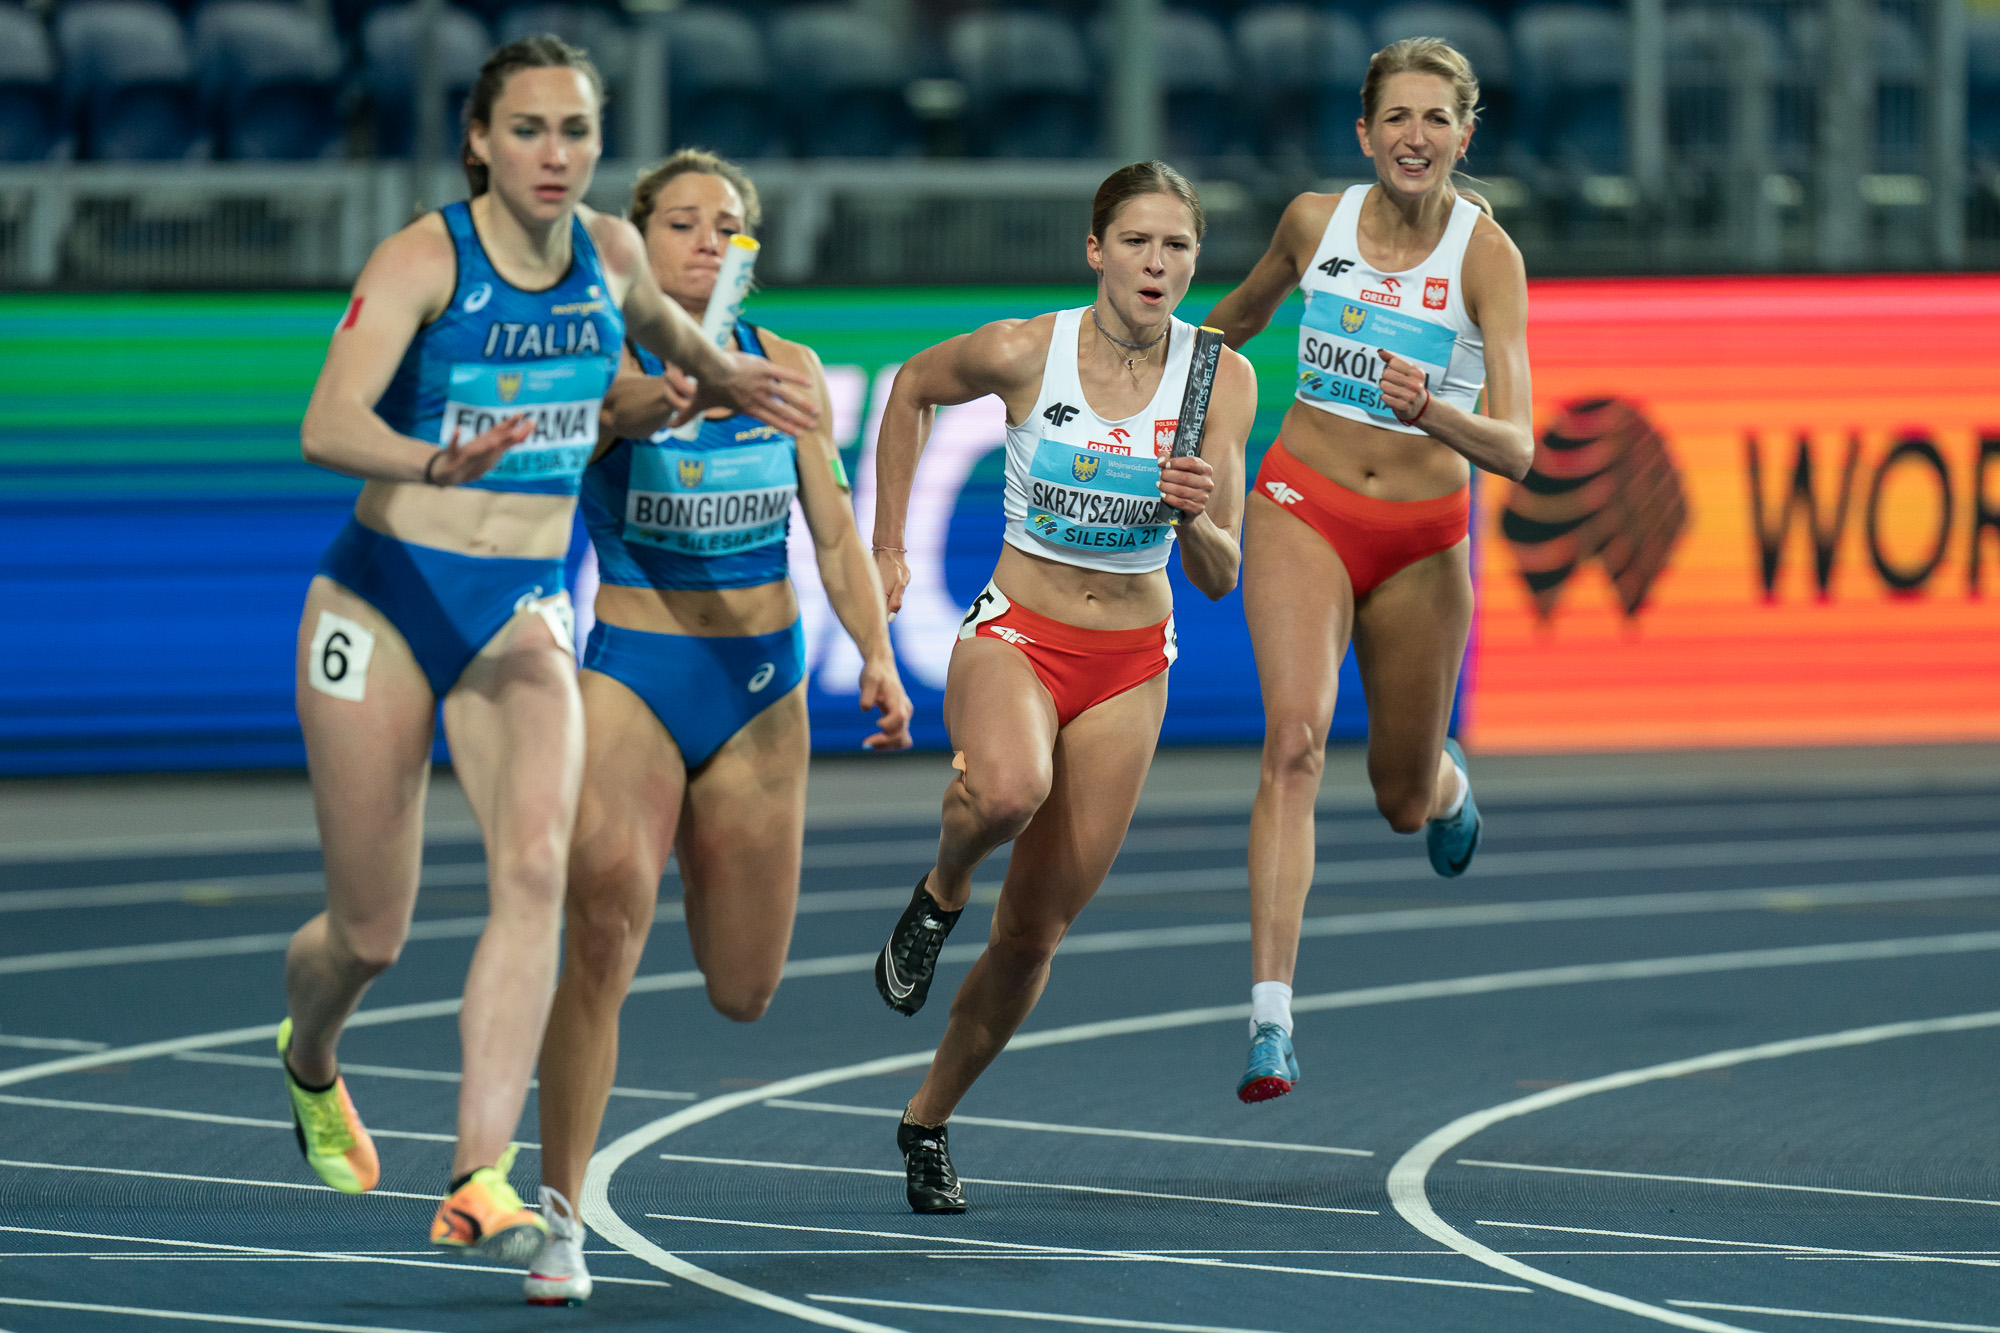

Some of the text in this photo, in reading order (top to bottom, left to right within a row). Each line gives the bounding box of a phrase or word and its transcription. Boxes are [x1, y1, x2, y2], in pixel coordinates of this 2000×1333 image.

[1318, 257, 1355, 277] 4F
[1362, 291, 1399, 306] ORLEN
[484, 319, 600, 357] ITALIA
[1304, 337, 1430, 391] SOKÓL
[1189, 388, 1210, 449] ATHLETICS
[1202, 343, 1219, 388] RELAYS
[456, 406, 587, 442] FOANA
[1043, 402, 1080, 427] 4F
[1089, 443, 1130, 456] ORLEN
[1105, 468, 1132, 479] Śląskie
[1107, 459, 1158, 473] Województwo
[1033, 482, 1162, 525] SKRZYSZOWSK
[1265, 481, 1304, 505] 4F
[677, 532, 752, 551] SILESIA
[1064, 527, 1158, 548] SILESIA 21
[323, 631, 351, 682] 6
